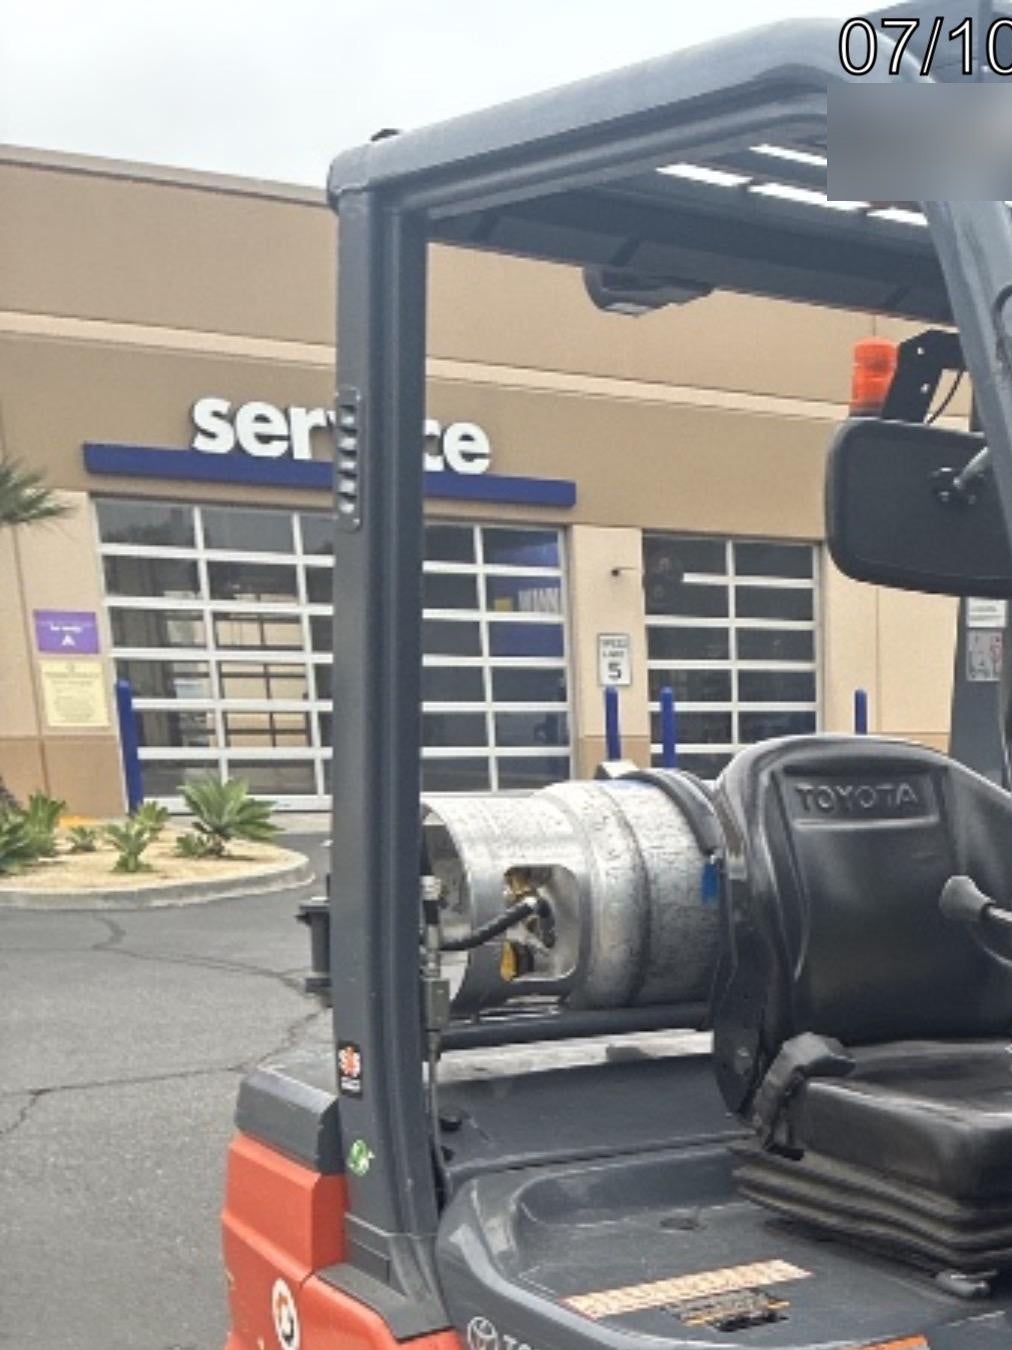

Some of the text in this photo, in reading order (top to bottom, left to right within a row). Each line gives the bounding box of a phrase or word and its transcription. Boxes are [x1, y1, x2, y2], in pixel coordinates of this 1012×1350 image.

[192, 397, 491, 475] serce
[607, 661, 622, 680] 5
[796, 783, 918, 813] TOYOTA
